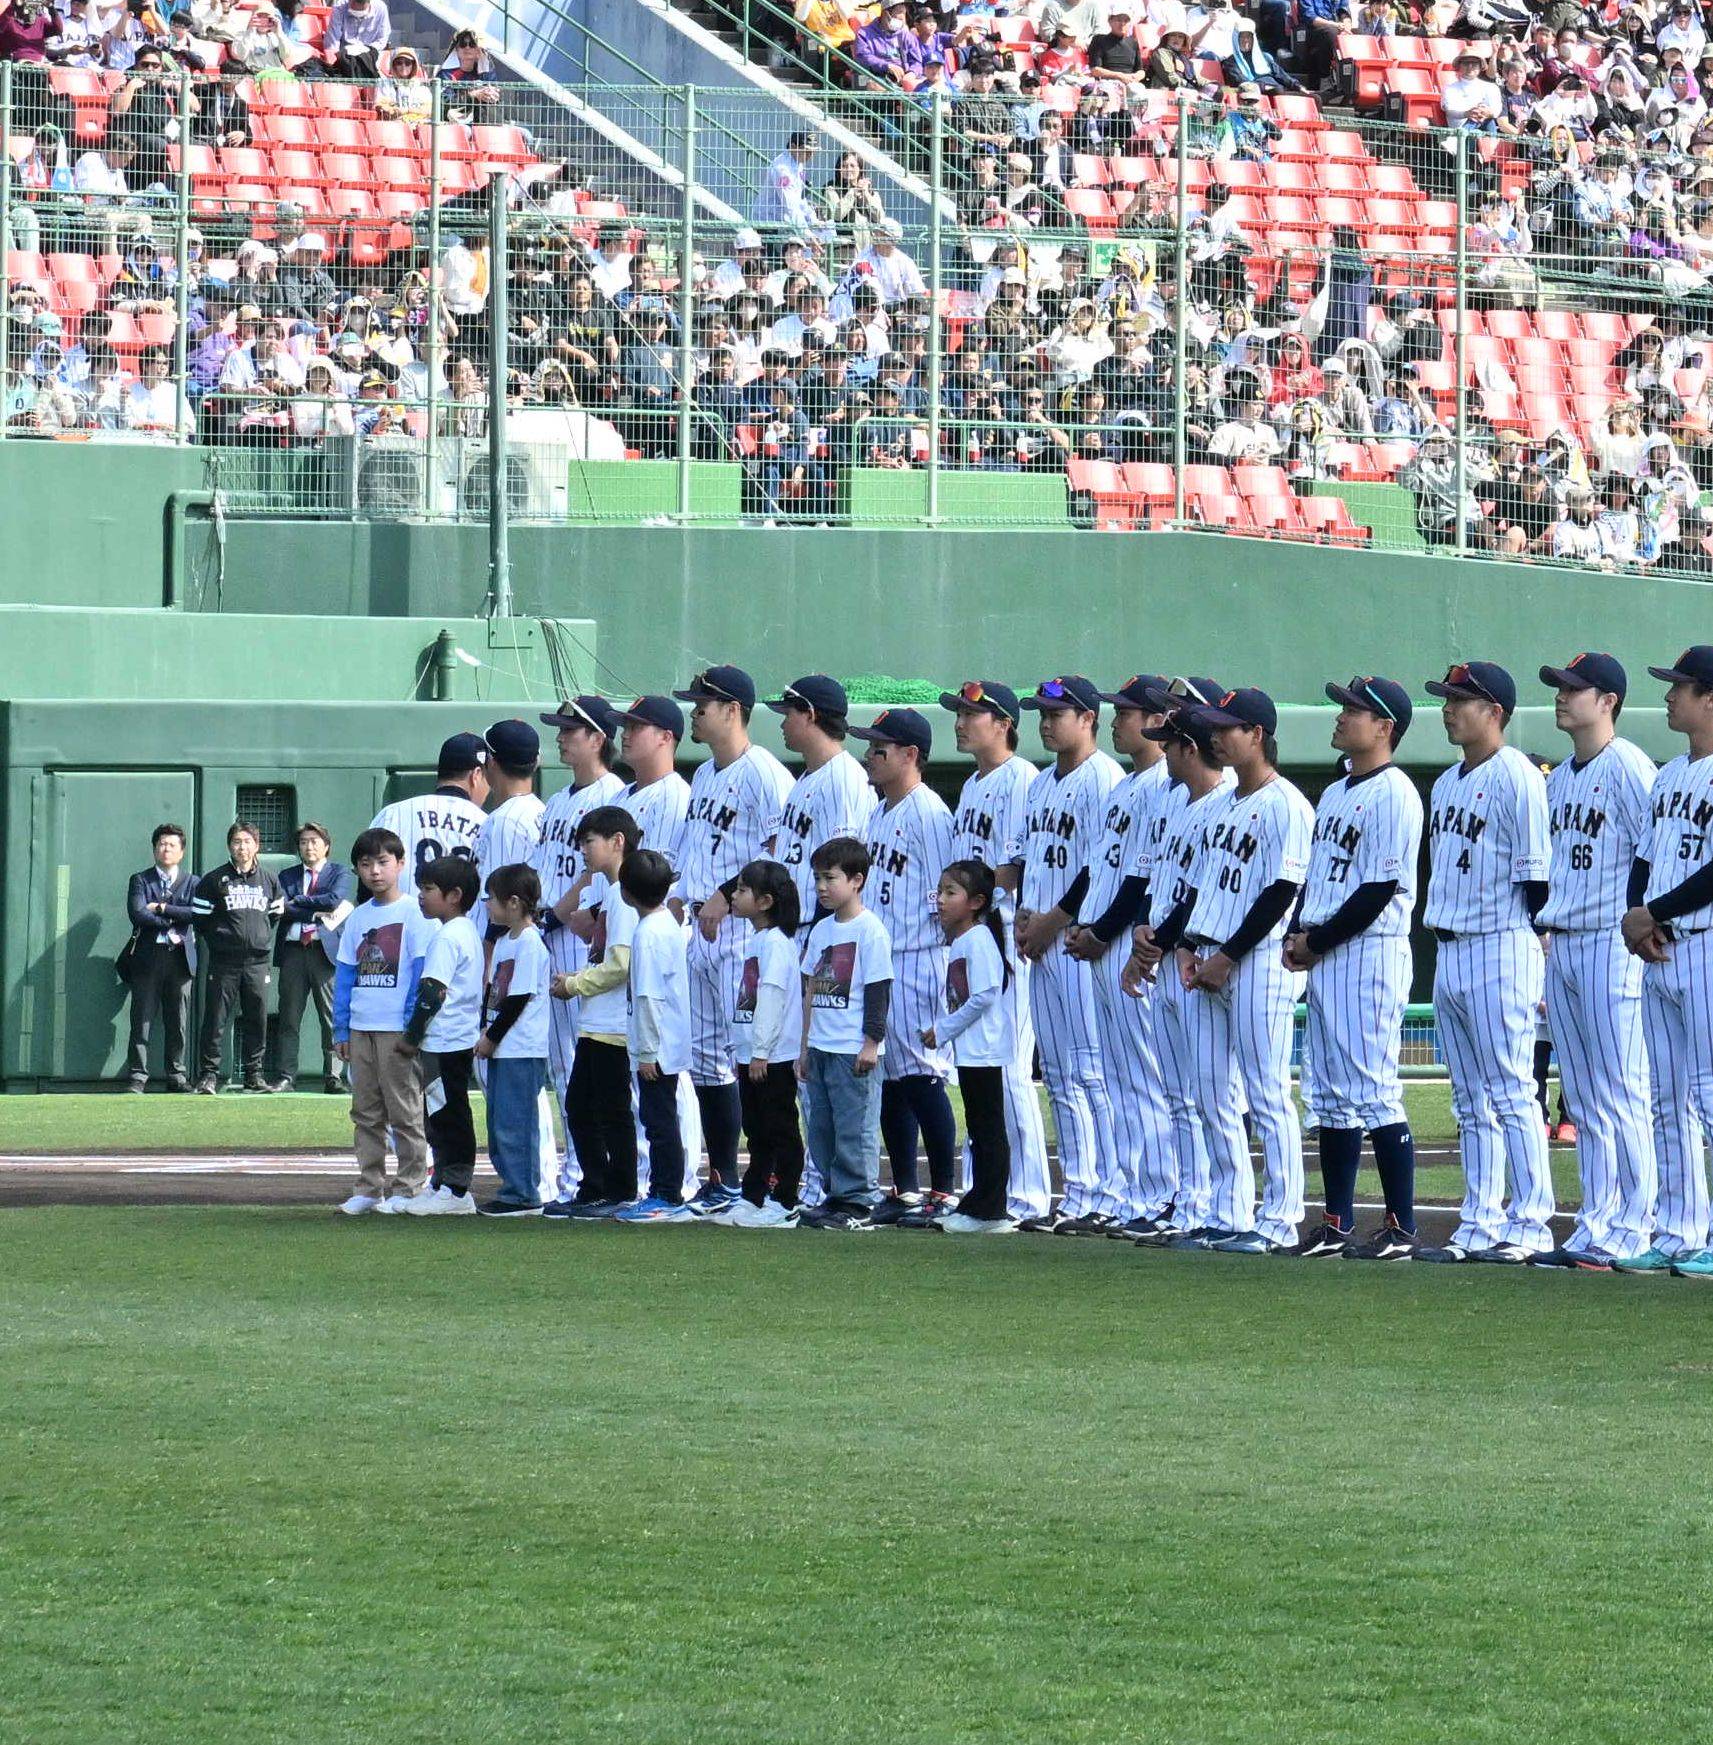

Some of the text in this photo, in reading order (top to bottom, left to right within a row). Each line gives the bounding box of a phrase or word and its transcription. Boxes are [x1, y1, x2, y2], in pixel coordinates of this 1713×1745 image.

[416, 809, 481, 841] IBATA
[684, 798, 736, 832] APAN
[953, 808, 993, 841] APAN
[1429, 806, 1487, 844] APAN
[1550, 802, 1605, 839] APAN
[711, 834, 722, 855] 7
[1200, 819, 1257, 864] APAN
[1312, 815, 1362, 856] APAN
[1678, 834, 1705, 861] 57
[1043, 844, 1067, 869] 40
[1456, 849, 1471, 875] 4
[1571, 844, 1593, 871] 66
[880, 881, 891, 905] 5
[1219, 865, 1242, 894] 00
